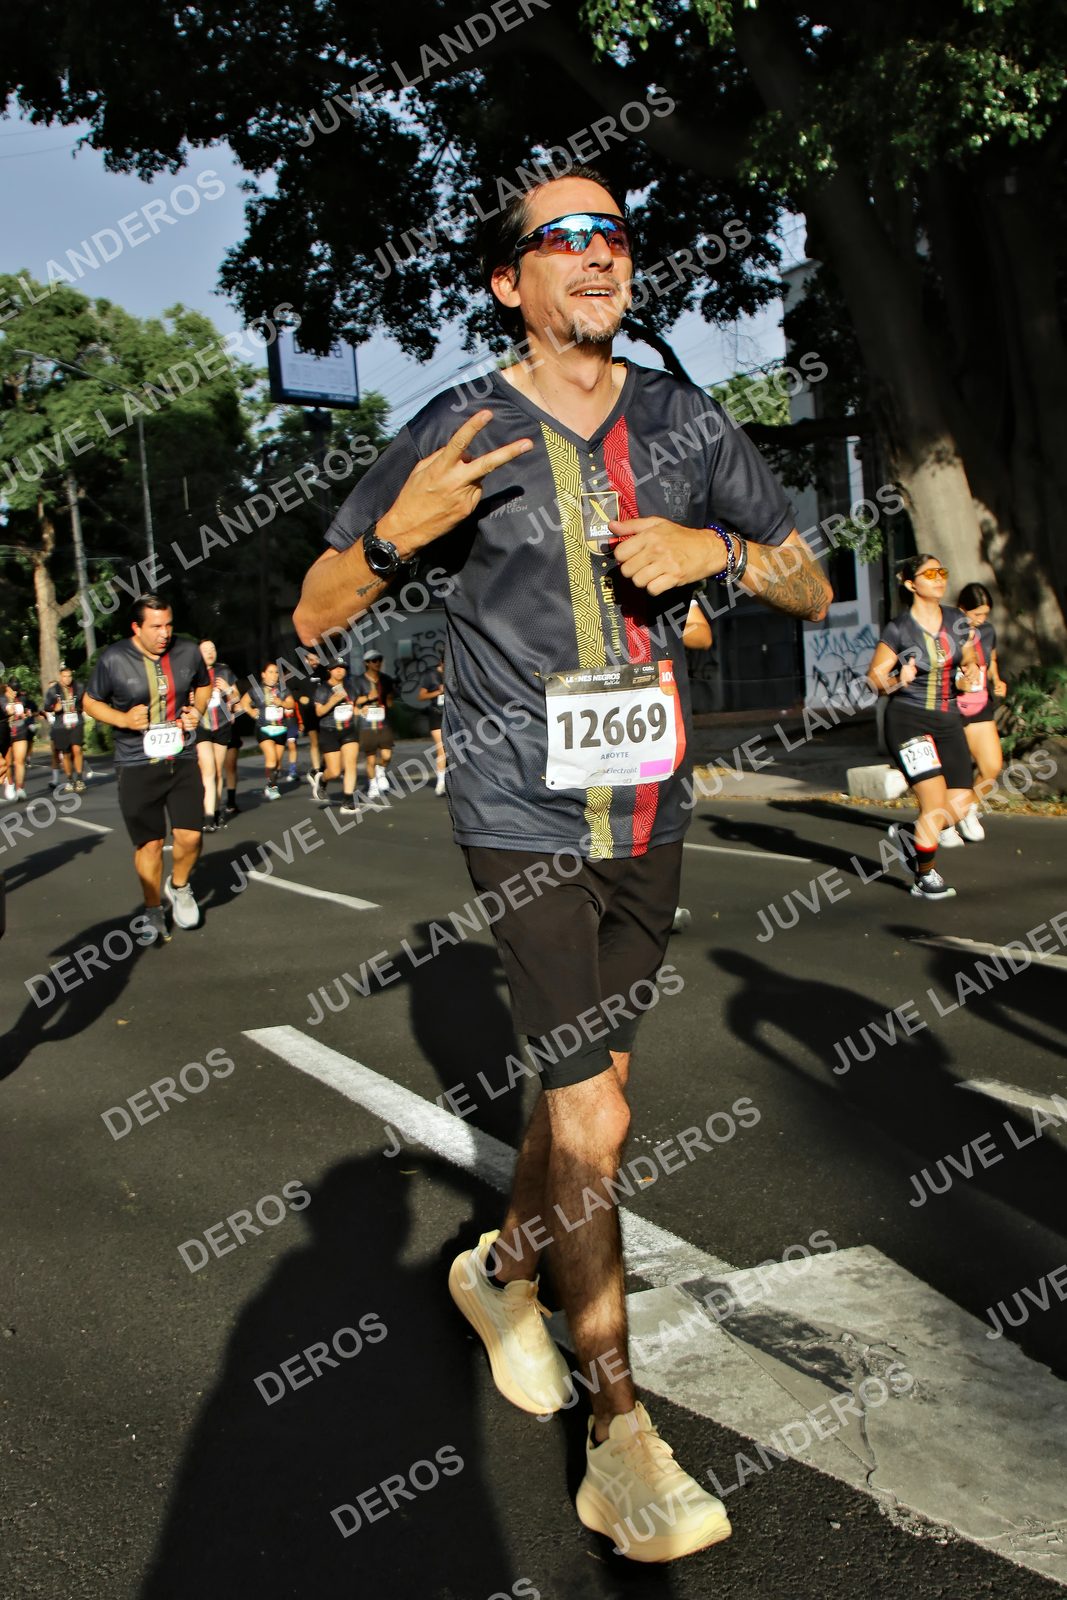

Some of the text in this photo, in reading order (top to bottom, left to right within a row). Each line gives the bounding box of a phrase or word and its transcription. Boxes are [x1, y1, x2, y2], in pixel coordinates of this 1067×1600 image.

[593, 673, 621, 682] NEGROS
[556, 702, 667, 750] 12669
[150, 732, 177, 745] 9727
[600, 751, 629, 760] ABOYTE
